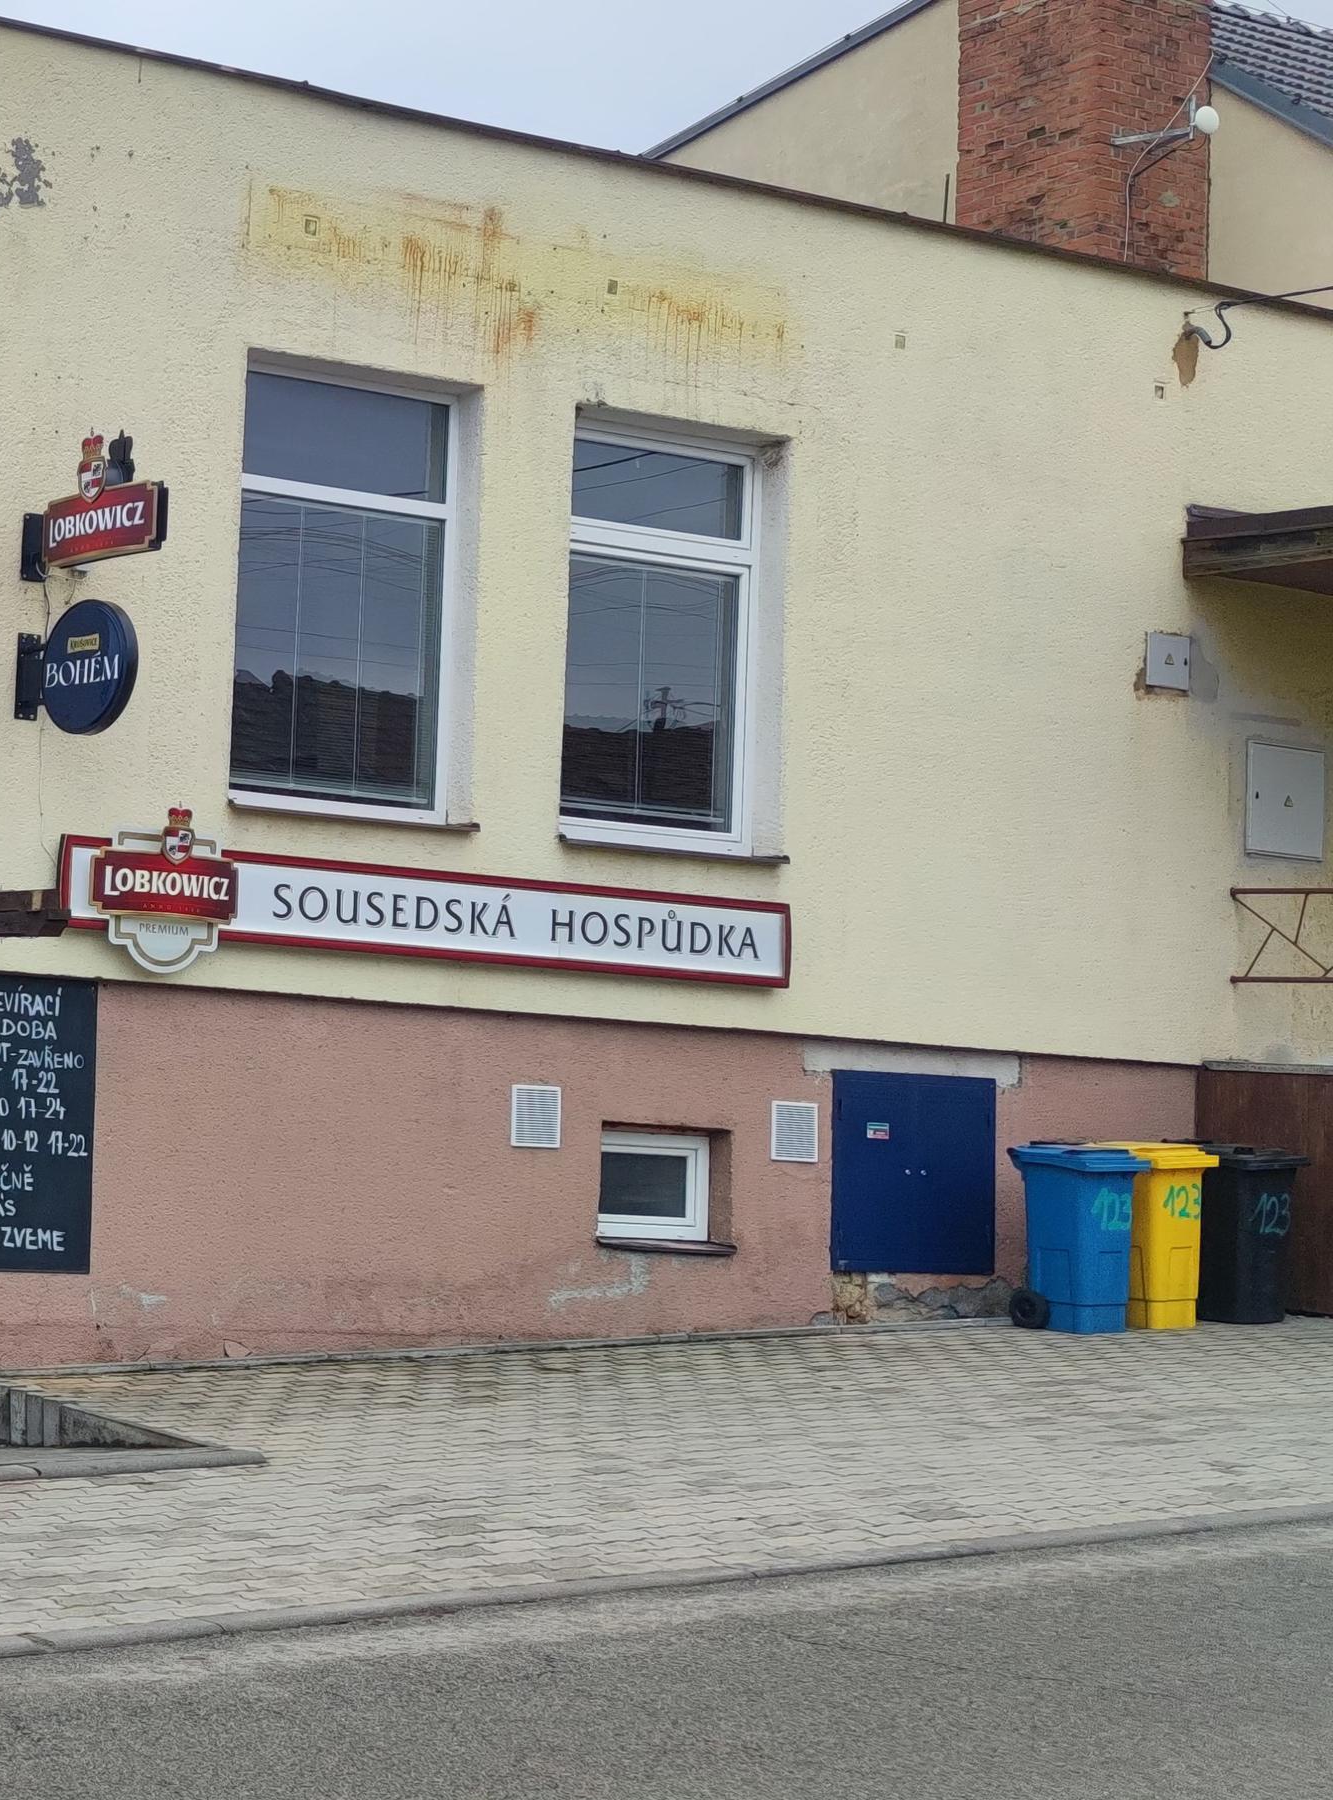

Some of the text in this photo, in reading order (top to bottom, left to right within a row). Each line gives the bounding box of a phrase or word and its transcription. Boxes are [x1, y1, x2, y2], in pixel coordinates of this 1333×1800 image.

[49, 501, 145, 548] LOBKOWICZ
[45, 651, 120, 688] BOHÉM
[104, 865, 230, 901] LOBKOWICZ
[139, 922, 189, 936] PREMIUM
[272, 884, 761, 960] SOUSEDSKÁ HOSPŮDKA
[0, 1018, 57, 1040] DOBA
[17, 1096, 67, 1120] 17-24
[1, 1128, 39, 1152] 10-12
[47, 1130, 88, 1157] 17-22
[1090, 1187, 1132, 1231] 123
[1163, 1183, 1201, 1219] 123
[1248, 1192, 1290, 1236] 123
[0, 1226, 66, 1251] ZVEME
